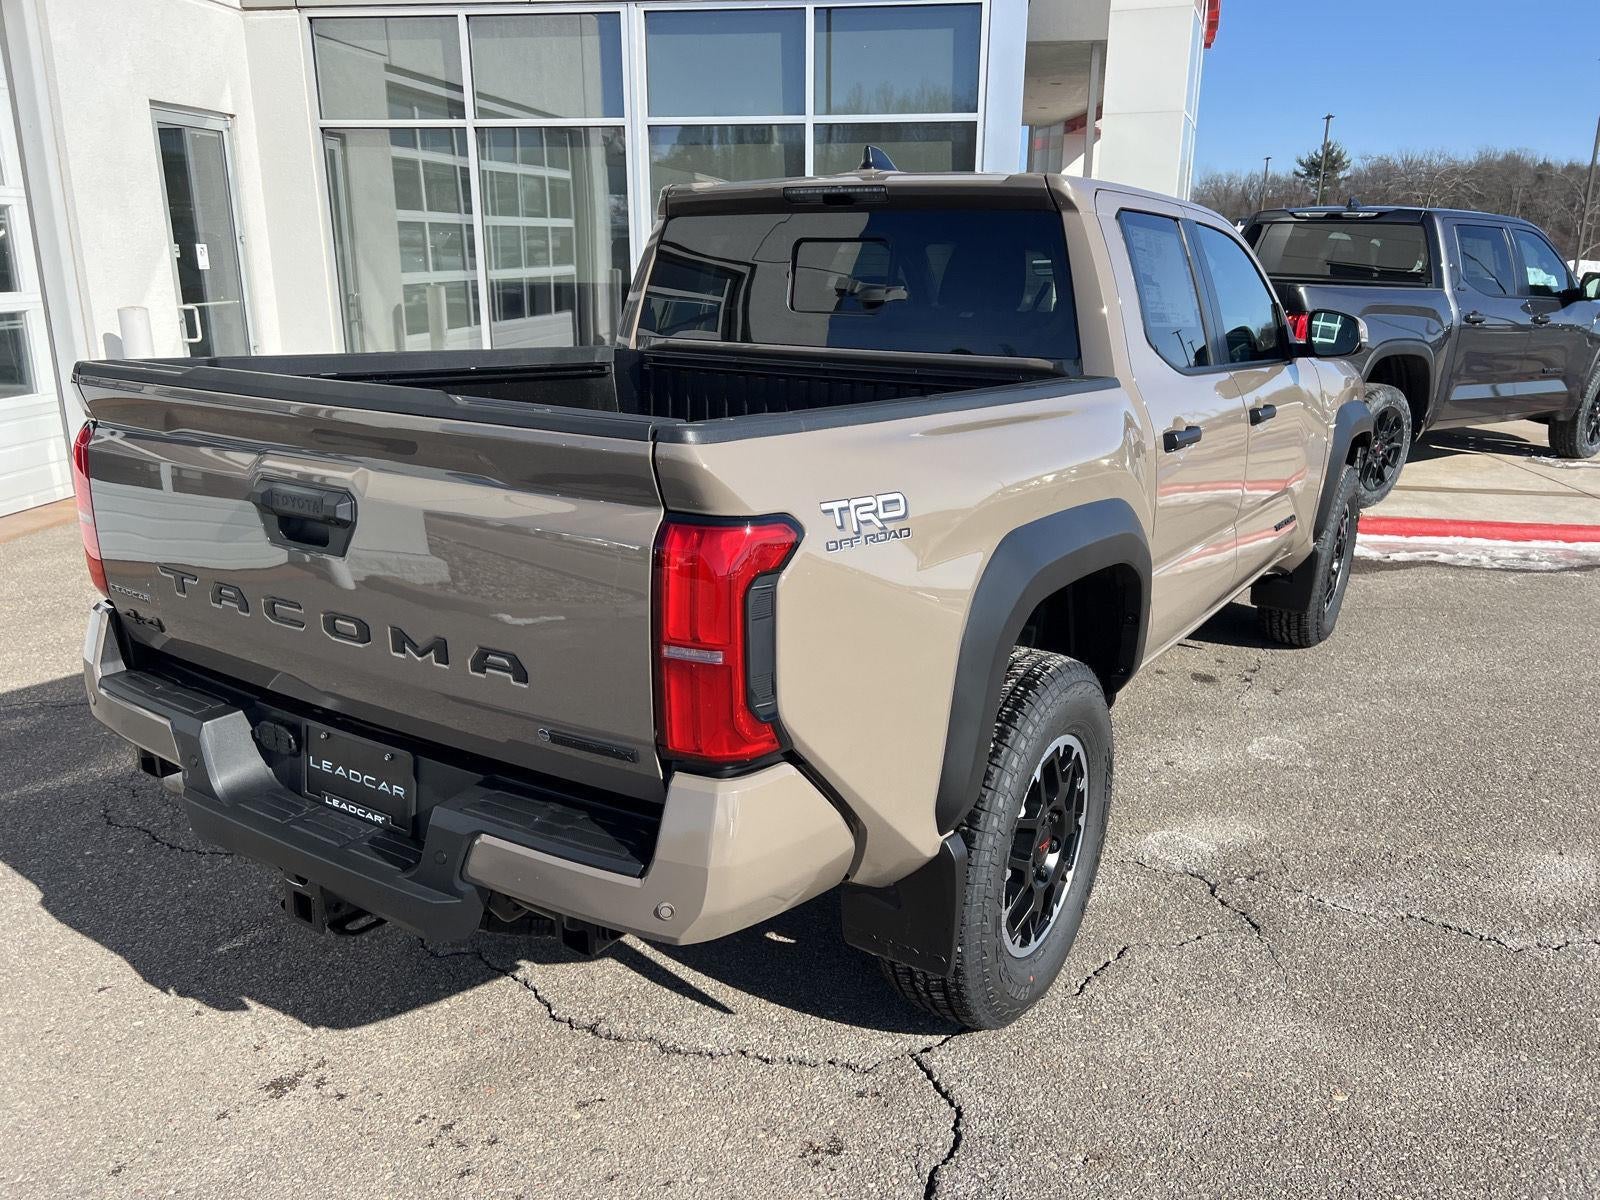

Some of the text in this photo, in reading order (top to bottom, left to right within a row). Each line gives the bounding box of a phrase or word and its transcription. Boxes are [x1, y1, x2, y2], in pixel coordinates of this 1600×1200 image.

[273, 493, 320, 514] TOYOTA
[820, 491, 907, 534] TRD
[826, 528, 912, 552] OFF ROAD
[156, 565, 530, 689] TACOMA
[309, 756, 405, 799] LEADCAR
